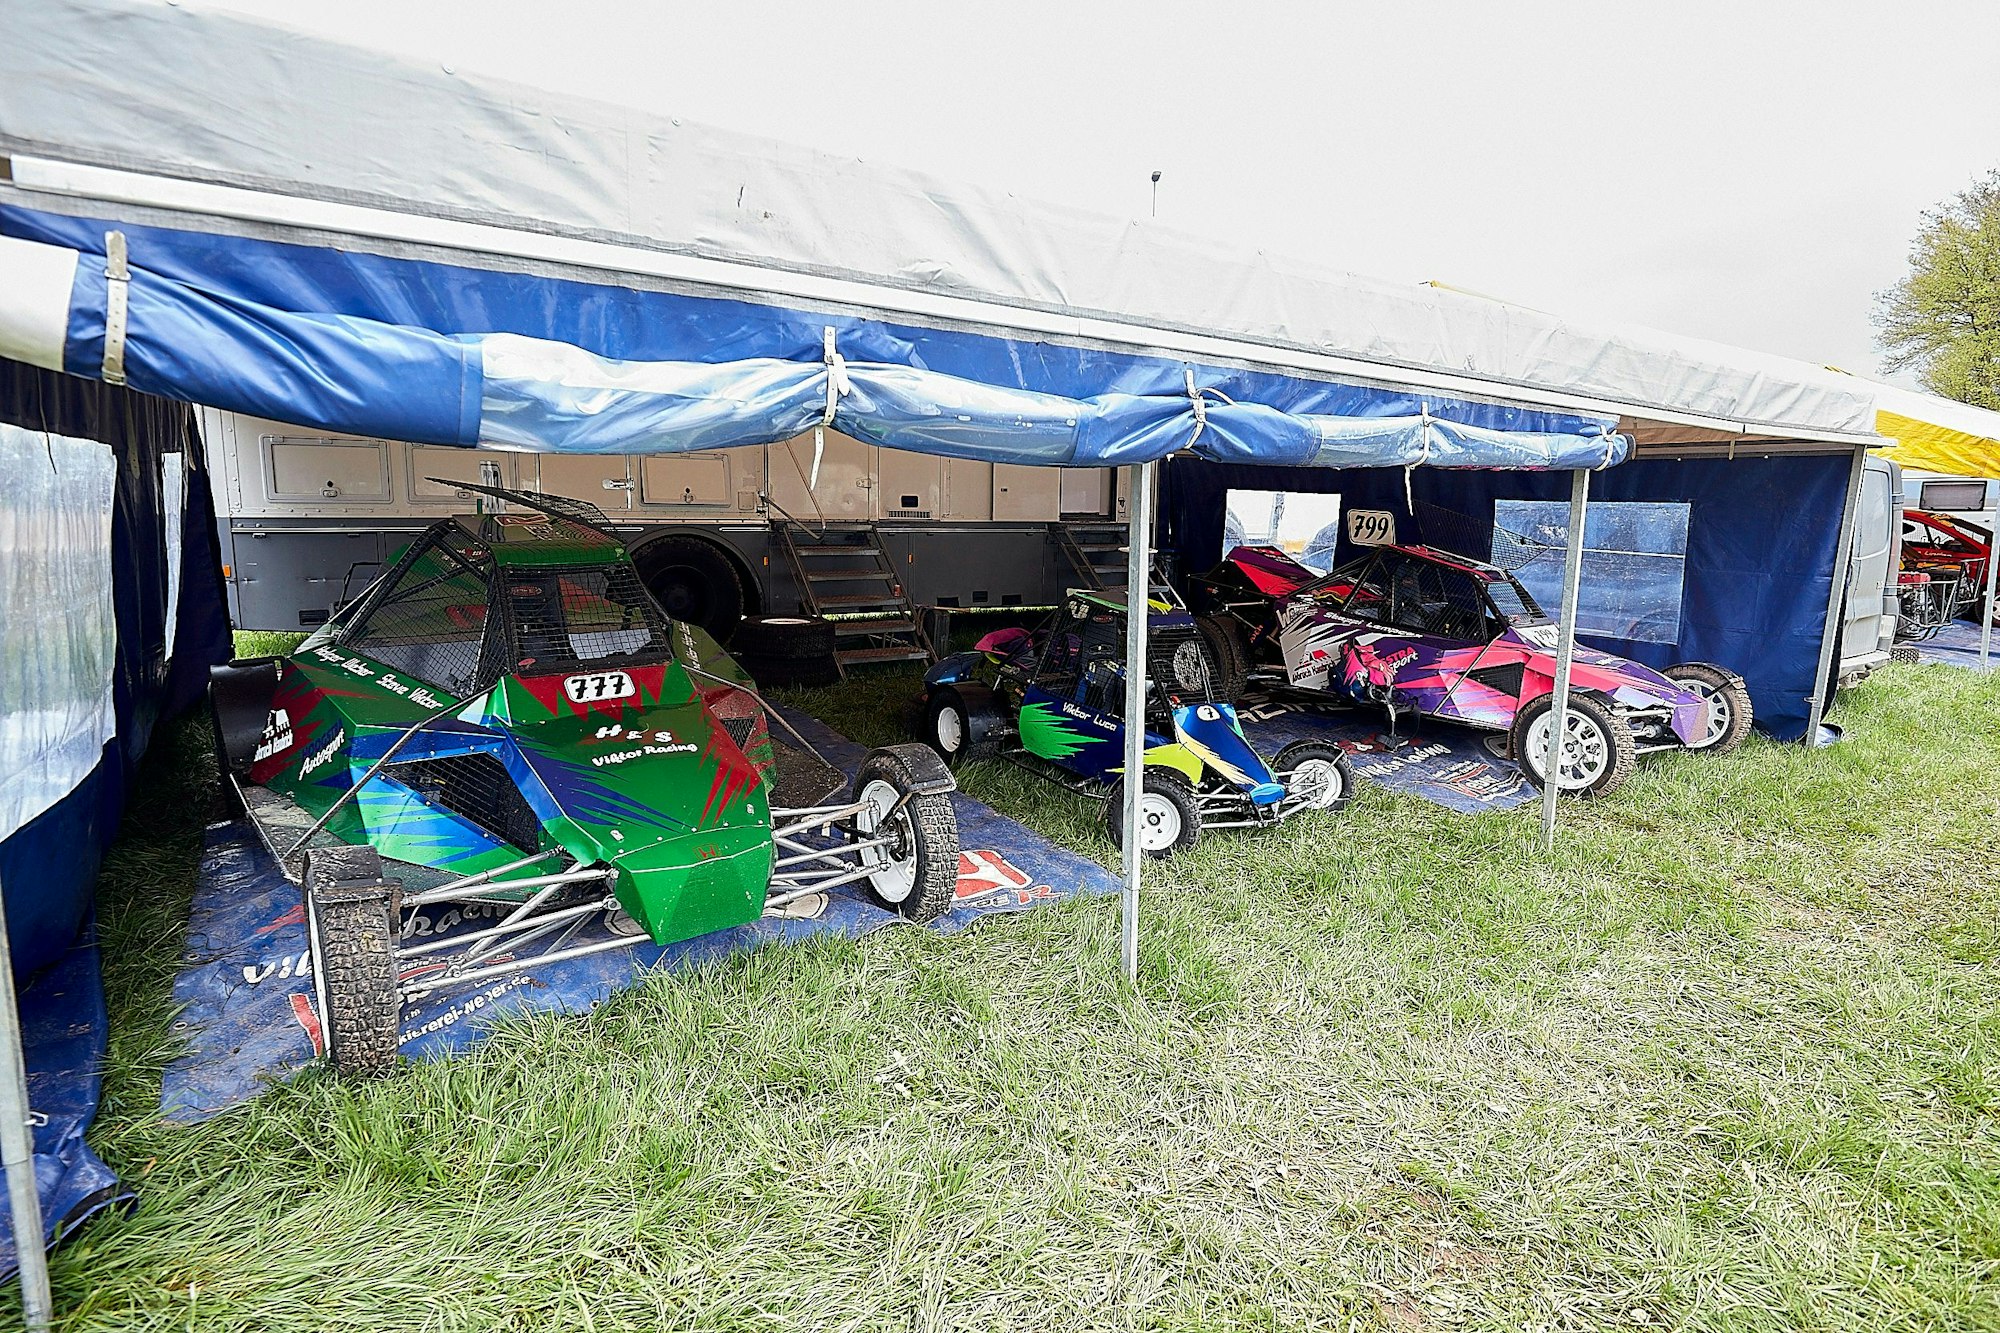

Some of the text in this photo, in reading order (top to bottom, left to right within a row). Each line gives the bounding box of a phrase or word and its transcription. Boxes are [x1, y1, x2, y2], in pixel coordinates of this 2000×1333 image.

[1354, 515, 1390, 541] 799
[375, 673, 410, 695] Steve
[571, 674, 626, 700] 777
[1062, 701, 1118, 732] Viktor Luca
[642, 743, 699, 757] Racing
[654, 731, 674, 743] S
[298, 727, 345, 781] Autosport
